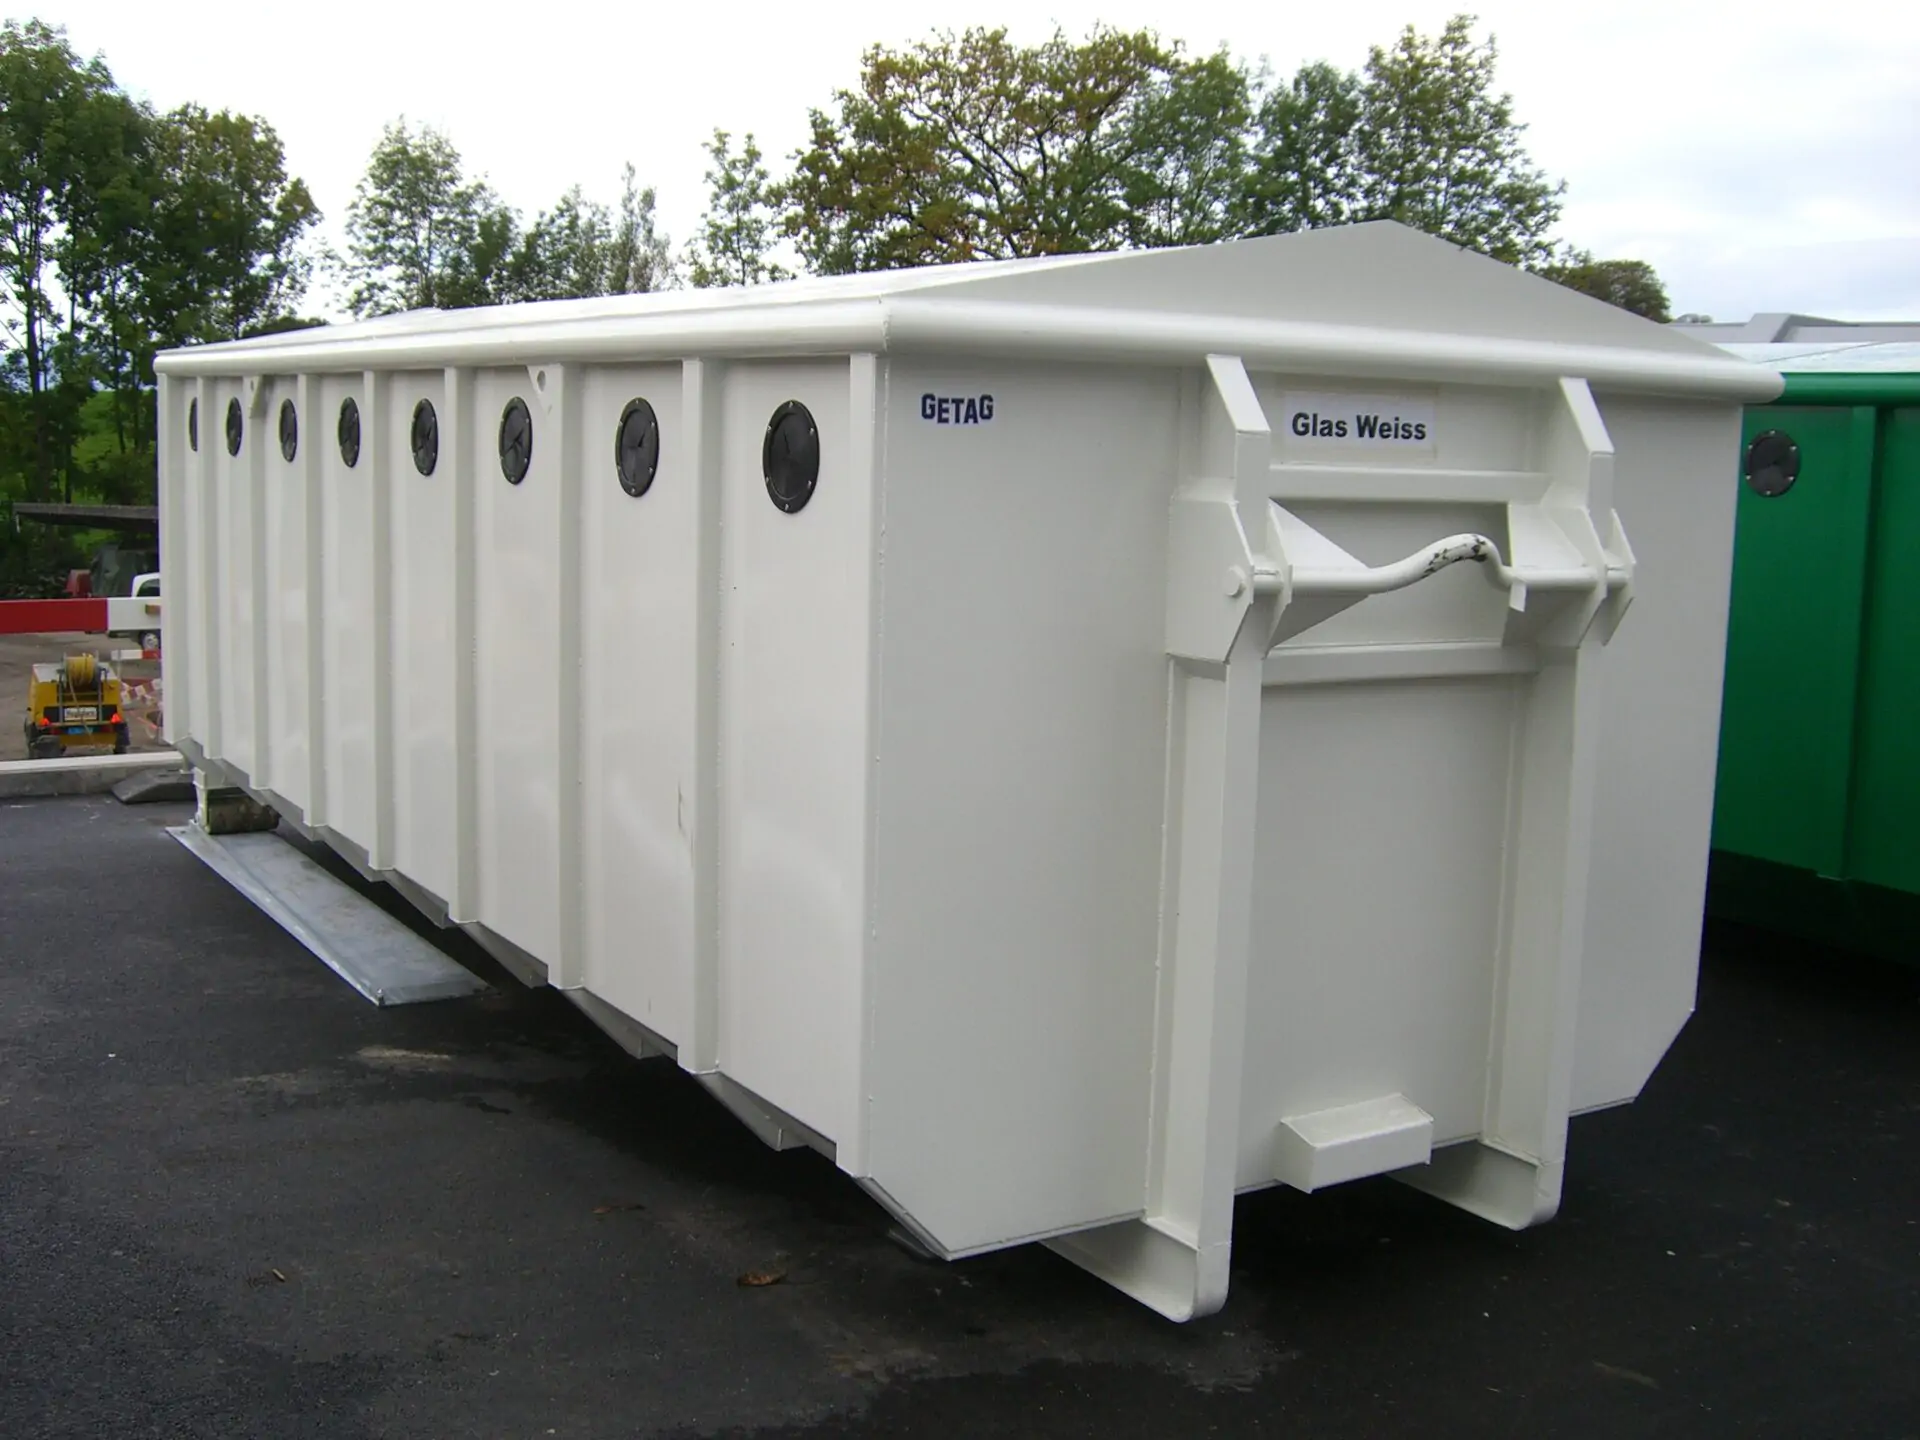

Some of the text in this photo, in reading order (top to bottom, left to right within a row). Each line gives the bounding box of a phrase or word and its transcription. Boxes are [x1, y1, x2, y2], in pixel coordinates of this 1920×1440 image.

[921, 393, 994, 424] GETAG
[1292, 412, 1426, 440] Glas Weiss
